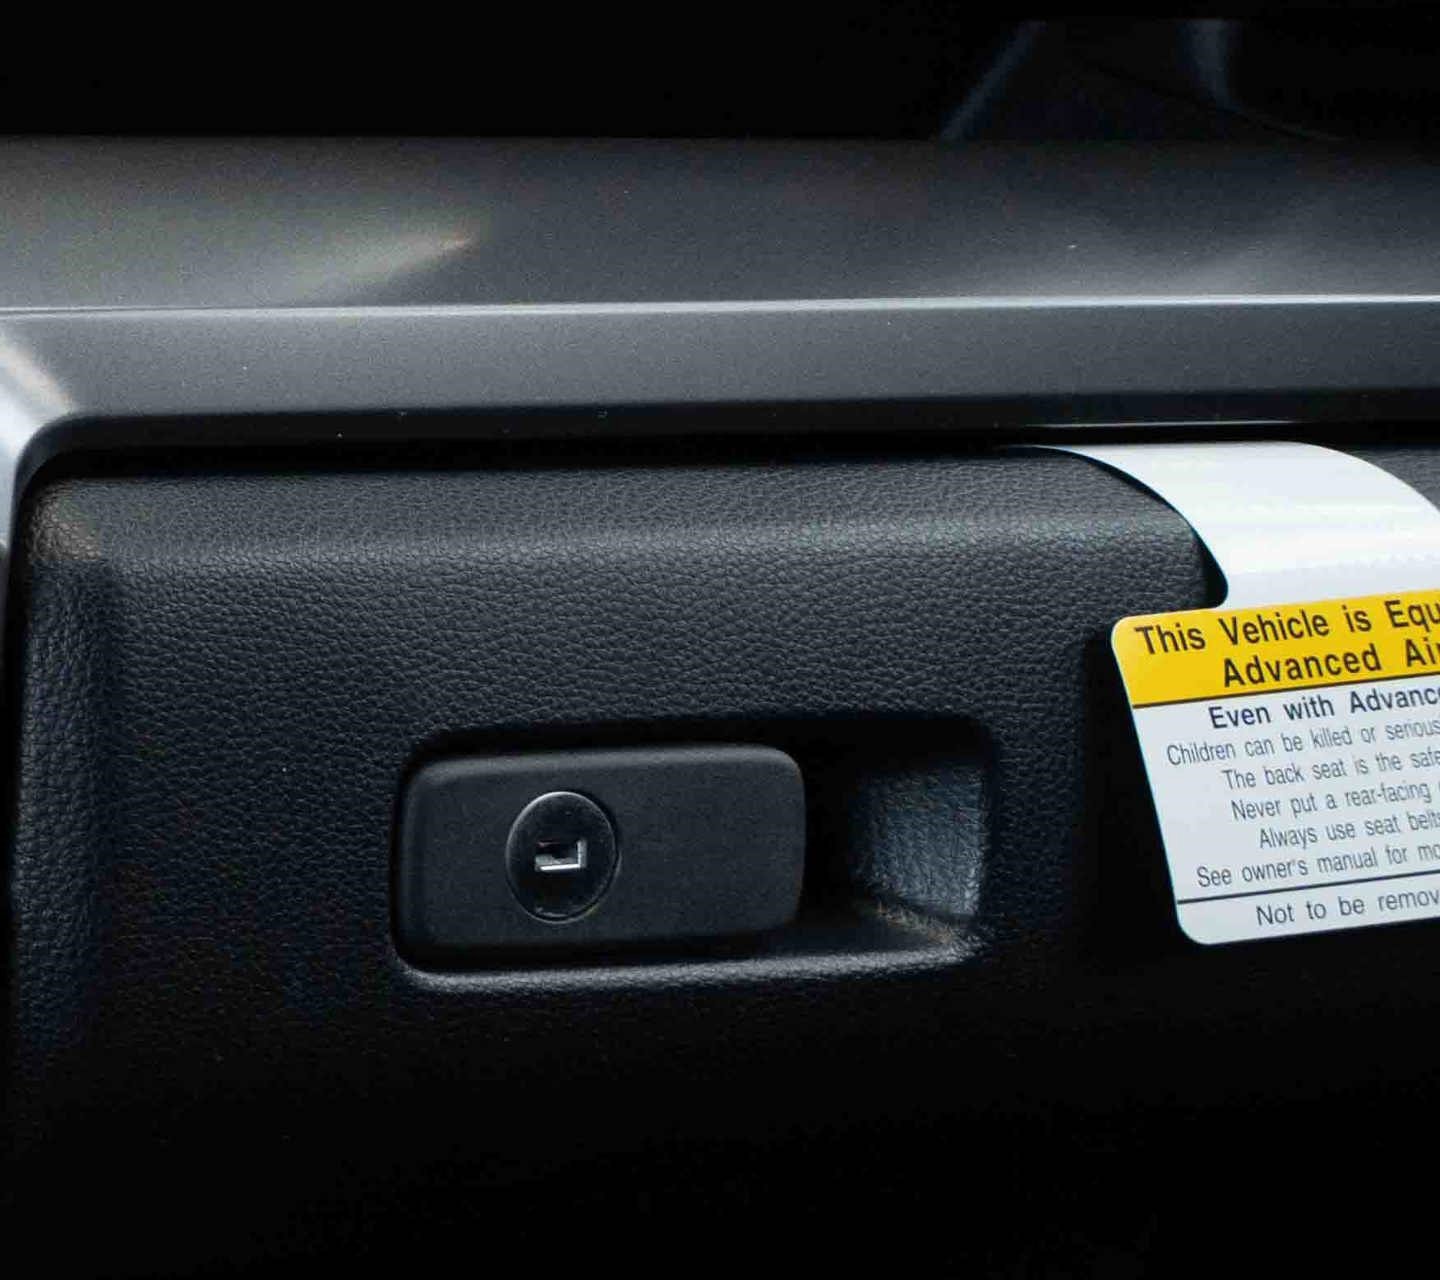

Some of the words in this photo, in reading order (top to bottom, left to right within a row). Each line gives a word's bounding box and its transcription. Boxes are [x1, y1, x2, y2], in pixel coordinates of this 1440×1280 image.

[1134, 622, 1206, 655] This
[1218, 609, 1330, 646] Vehicle
[1341, 605, 1372, 632] is
[1384, 599, 1440, 633] Equ
[1223, 642, 1382, 688] Advanced
[1208, 704, 1272, 729] Even
[1282, 694, 1335, 720] with
[1350, 688, 1440, 714] Advanc
[1167, 741, 1236, 766] Children
[1245, 737, 1275, 758] can
[1281, 732, 1303, 752] be
[1310, 726, 1353, 750] killed
[1360, 727, 1376, 745] or
[1221, 768, 1256, 791] The
[1263, 763, 1304, 786] back
[1312, 758, 1347, 781] seat
[1355, 756, 1369, 775] is
[1375, 751, 1402, 773] the
[1231, 798, 1280, 821] Never
[1290, 793, 1318, 818] put
[1326, 794, 1337, 810] a
[1344, 779, 1433, 807] rear-facing
[1260, 826, 1318, 850] Always
[1326, 822, 1356, 841] use
[1365, 814, 1401, 836] seat
[1196, 865, 1232, 888] See
[1241, 859, 1309, 883] owner's
[1317, 846, 1378, 873] manual
[1386, 845, 1408, 866] for
[1256, 902, 1295, 926] Not
[1307, 900, 1327, 921] to
[1338, 895, 1365, 917] be
[1378, 888, 1440, 912] remov
